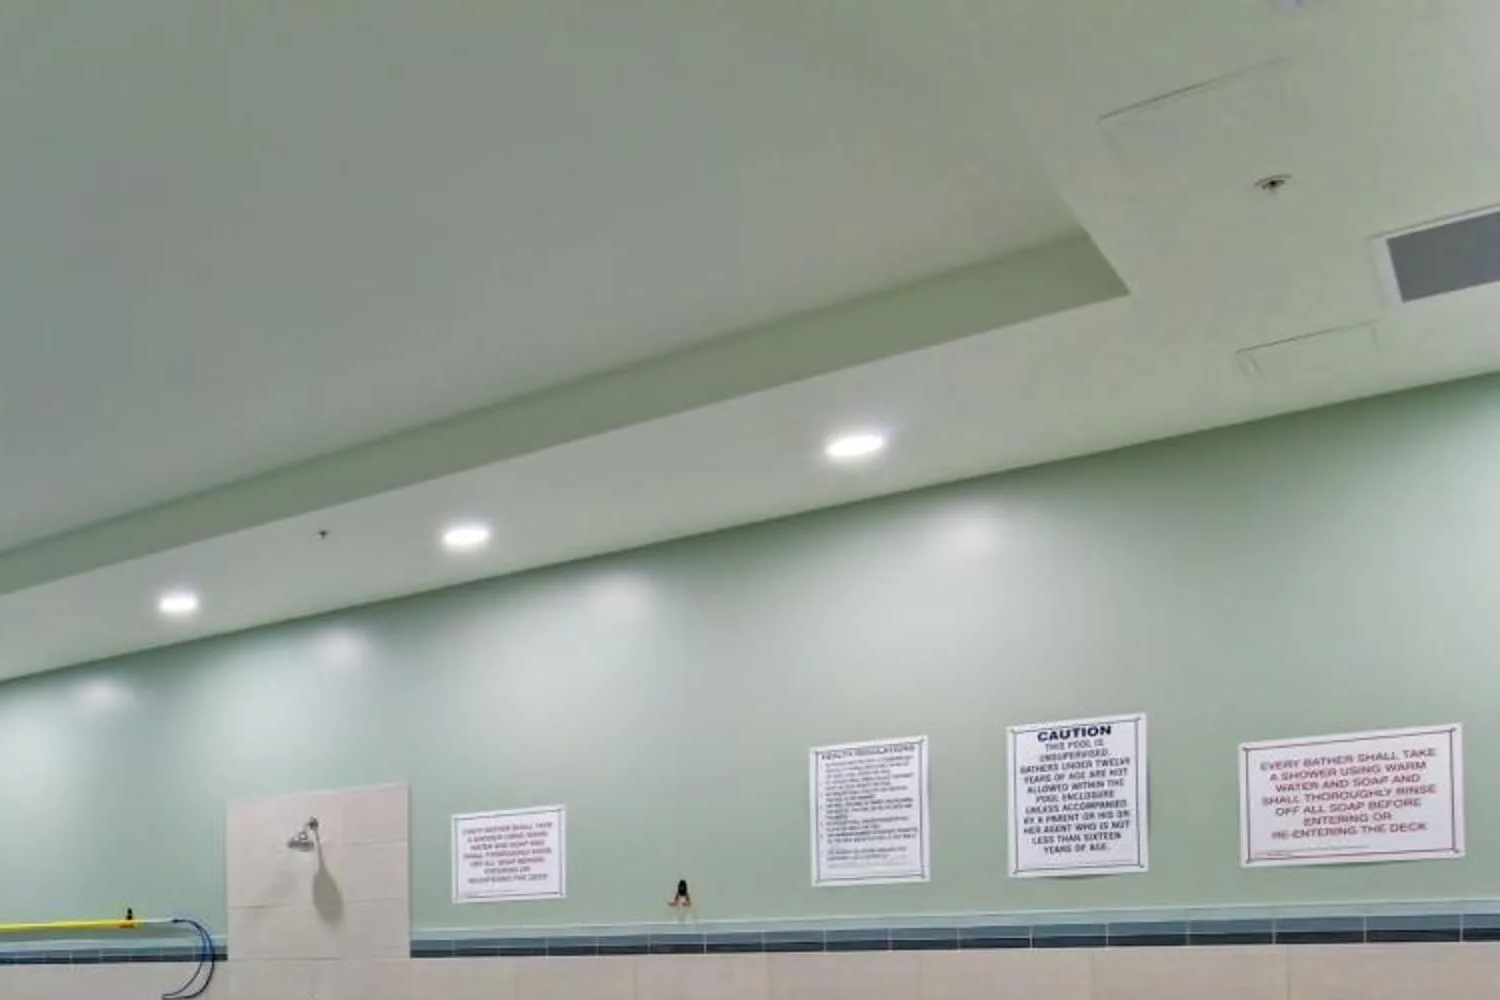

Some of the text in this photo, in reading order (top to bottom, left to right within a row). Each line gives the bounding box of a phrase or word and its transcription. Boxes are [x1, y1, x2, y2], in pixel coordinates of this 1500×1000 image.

[1037, 725, 1112, 742] CAUTION
[1068, 740, 1091, 749] POOL
[1260, 748, 1436, 771] EVERY BATHER SHALL TAKE
[1020, 763, 1058, 774] BATHERS
[1062, 761, 1093, 770] UNDER
[1282, 768, 1336, 780] SHOWER
[1340, 764, 1381, 776] USING
[1385, 761, 1426, 771] WARM
[1024, 768, 1127, 784] YEARS OF AGE ARE NOT
[1275, 774, 1420, 793] WATER AND SOAP AND
[1028, 784, 1068, 794] ALLOWED
[1072, 782, 1104, 791] WITHIN
[1262, 784, 1436, 806] SHALL THOROUGHLY RINSE
[1275, 798, 1421, 816] OFF ALL SOAP BEFORE
[1046, 813, 1079, 823] PARENT
[1082, 813, 1096, 821] OR
[1304, 812, 1392, 826] ENTERING OR
[1023, 826, 1041, 834] HER
[1076, 822, 1096, 831] WHO
[1112, 820, 1130, 829] NOT
[1272, 822, 1427, 840] RE-ENTERING THE DECK
[1032, 831, 1121, 844] LESS THAN SIXTEEN
[1044, 845, 1071, 854] YEARS
